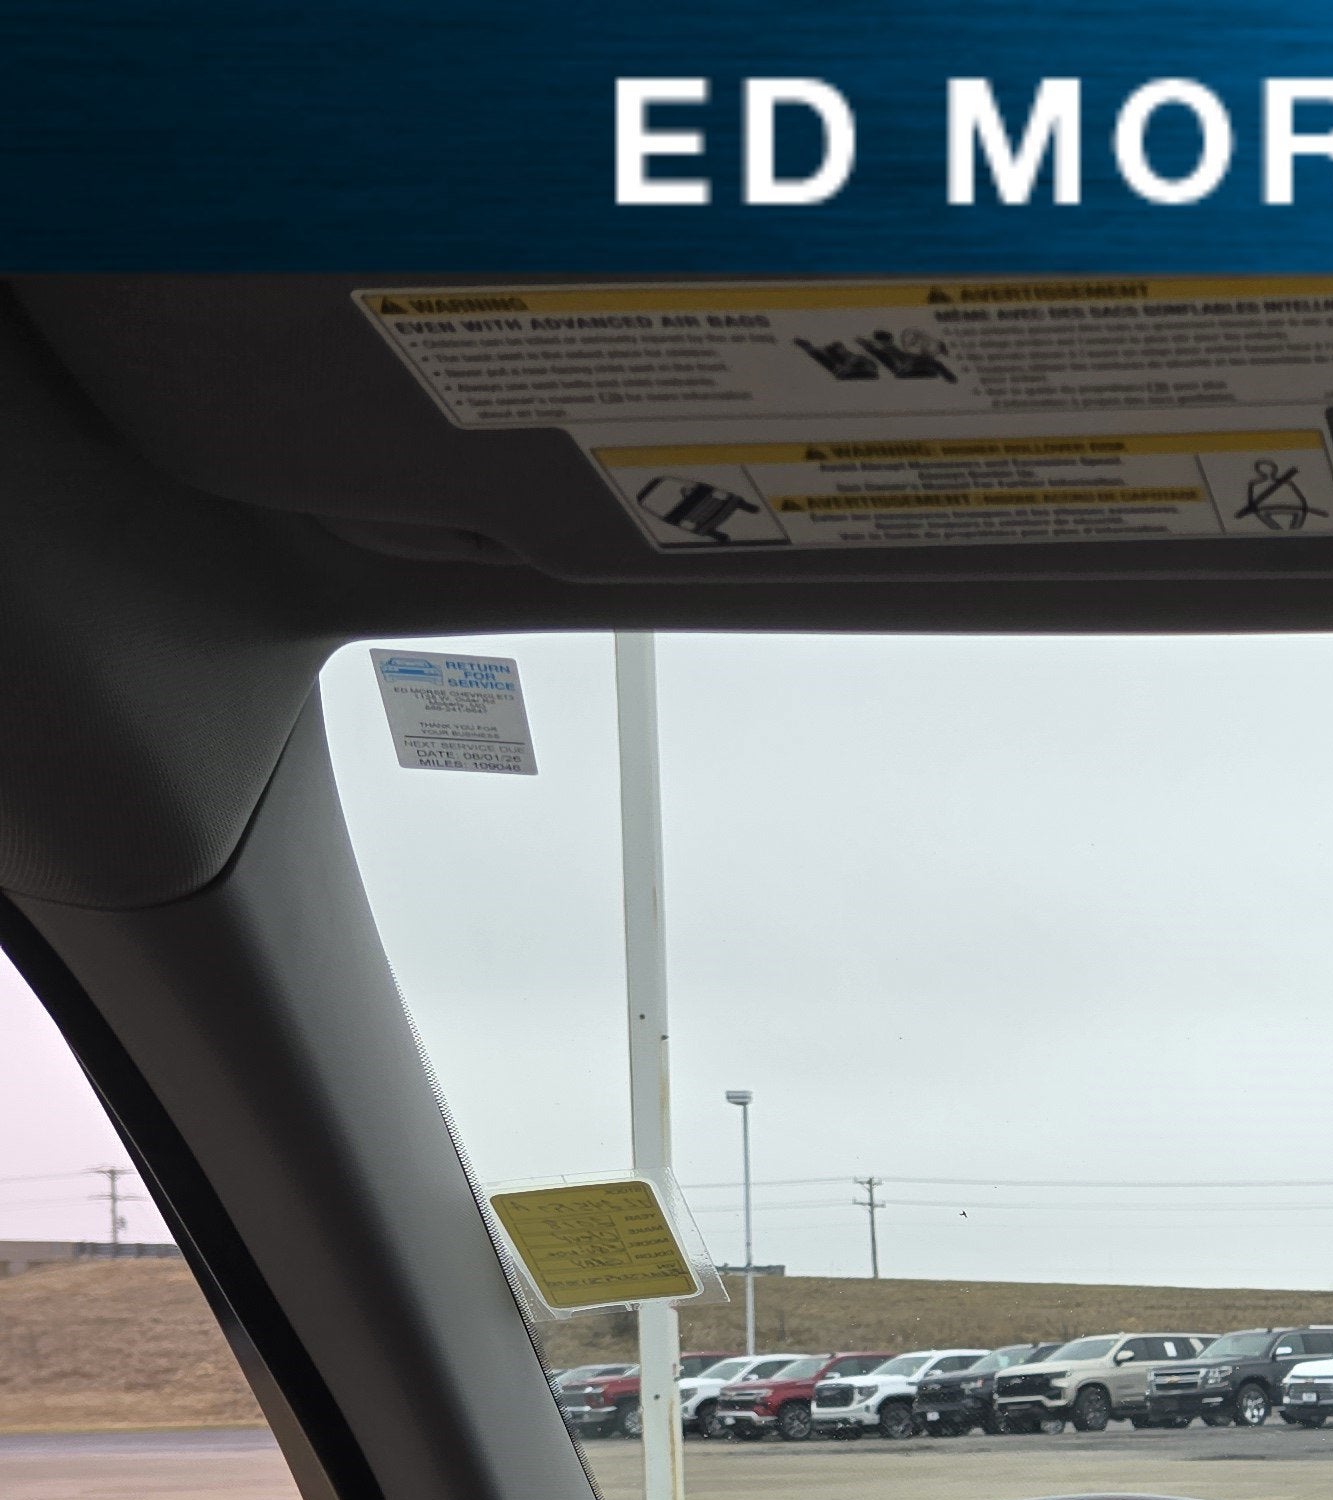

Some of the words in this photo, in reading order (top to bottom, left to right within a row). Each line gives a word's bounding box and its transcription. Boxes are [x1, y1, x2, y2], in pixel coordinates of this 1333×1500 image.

[395, 321, 456, 334] EVEN
[460, 319, 522, 332] WITH
[530, 316, 652, 330] ADVANCED
[662, 316, 700, 328] AIR
[706, 315, 770, 328] BAGS
[445, 660, 511, 674] RETURN
[464, 671, 496, 680] FOR
[448, 679, 515, 691] SERVICE
[404, 739, 436, 749] NEXT
[441, 742, 496, 752] SERVICE
[499, 746, 525, 754] DUE
